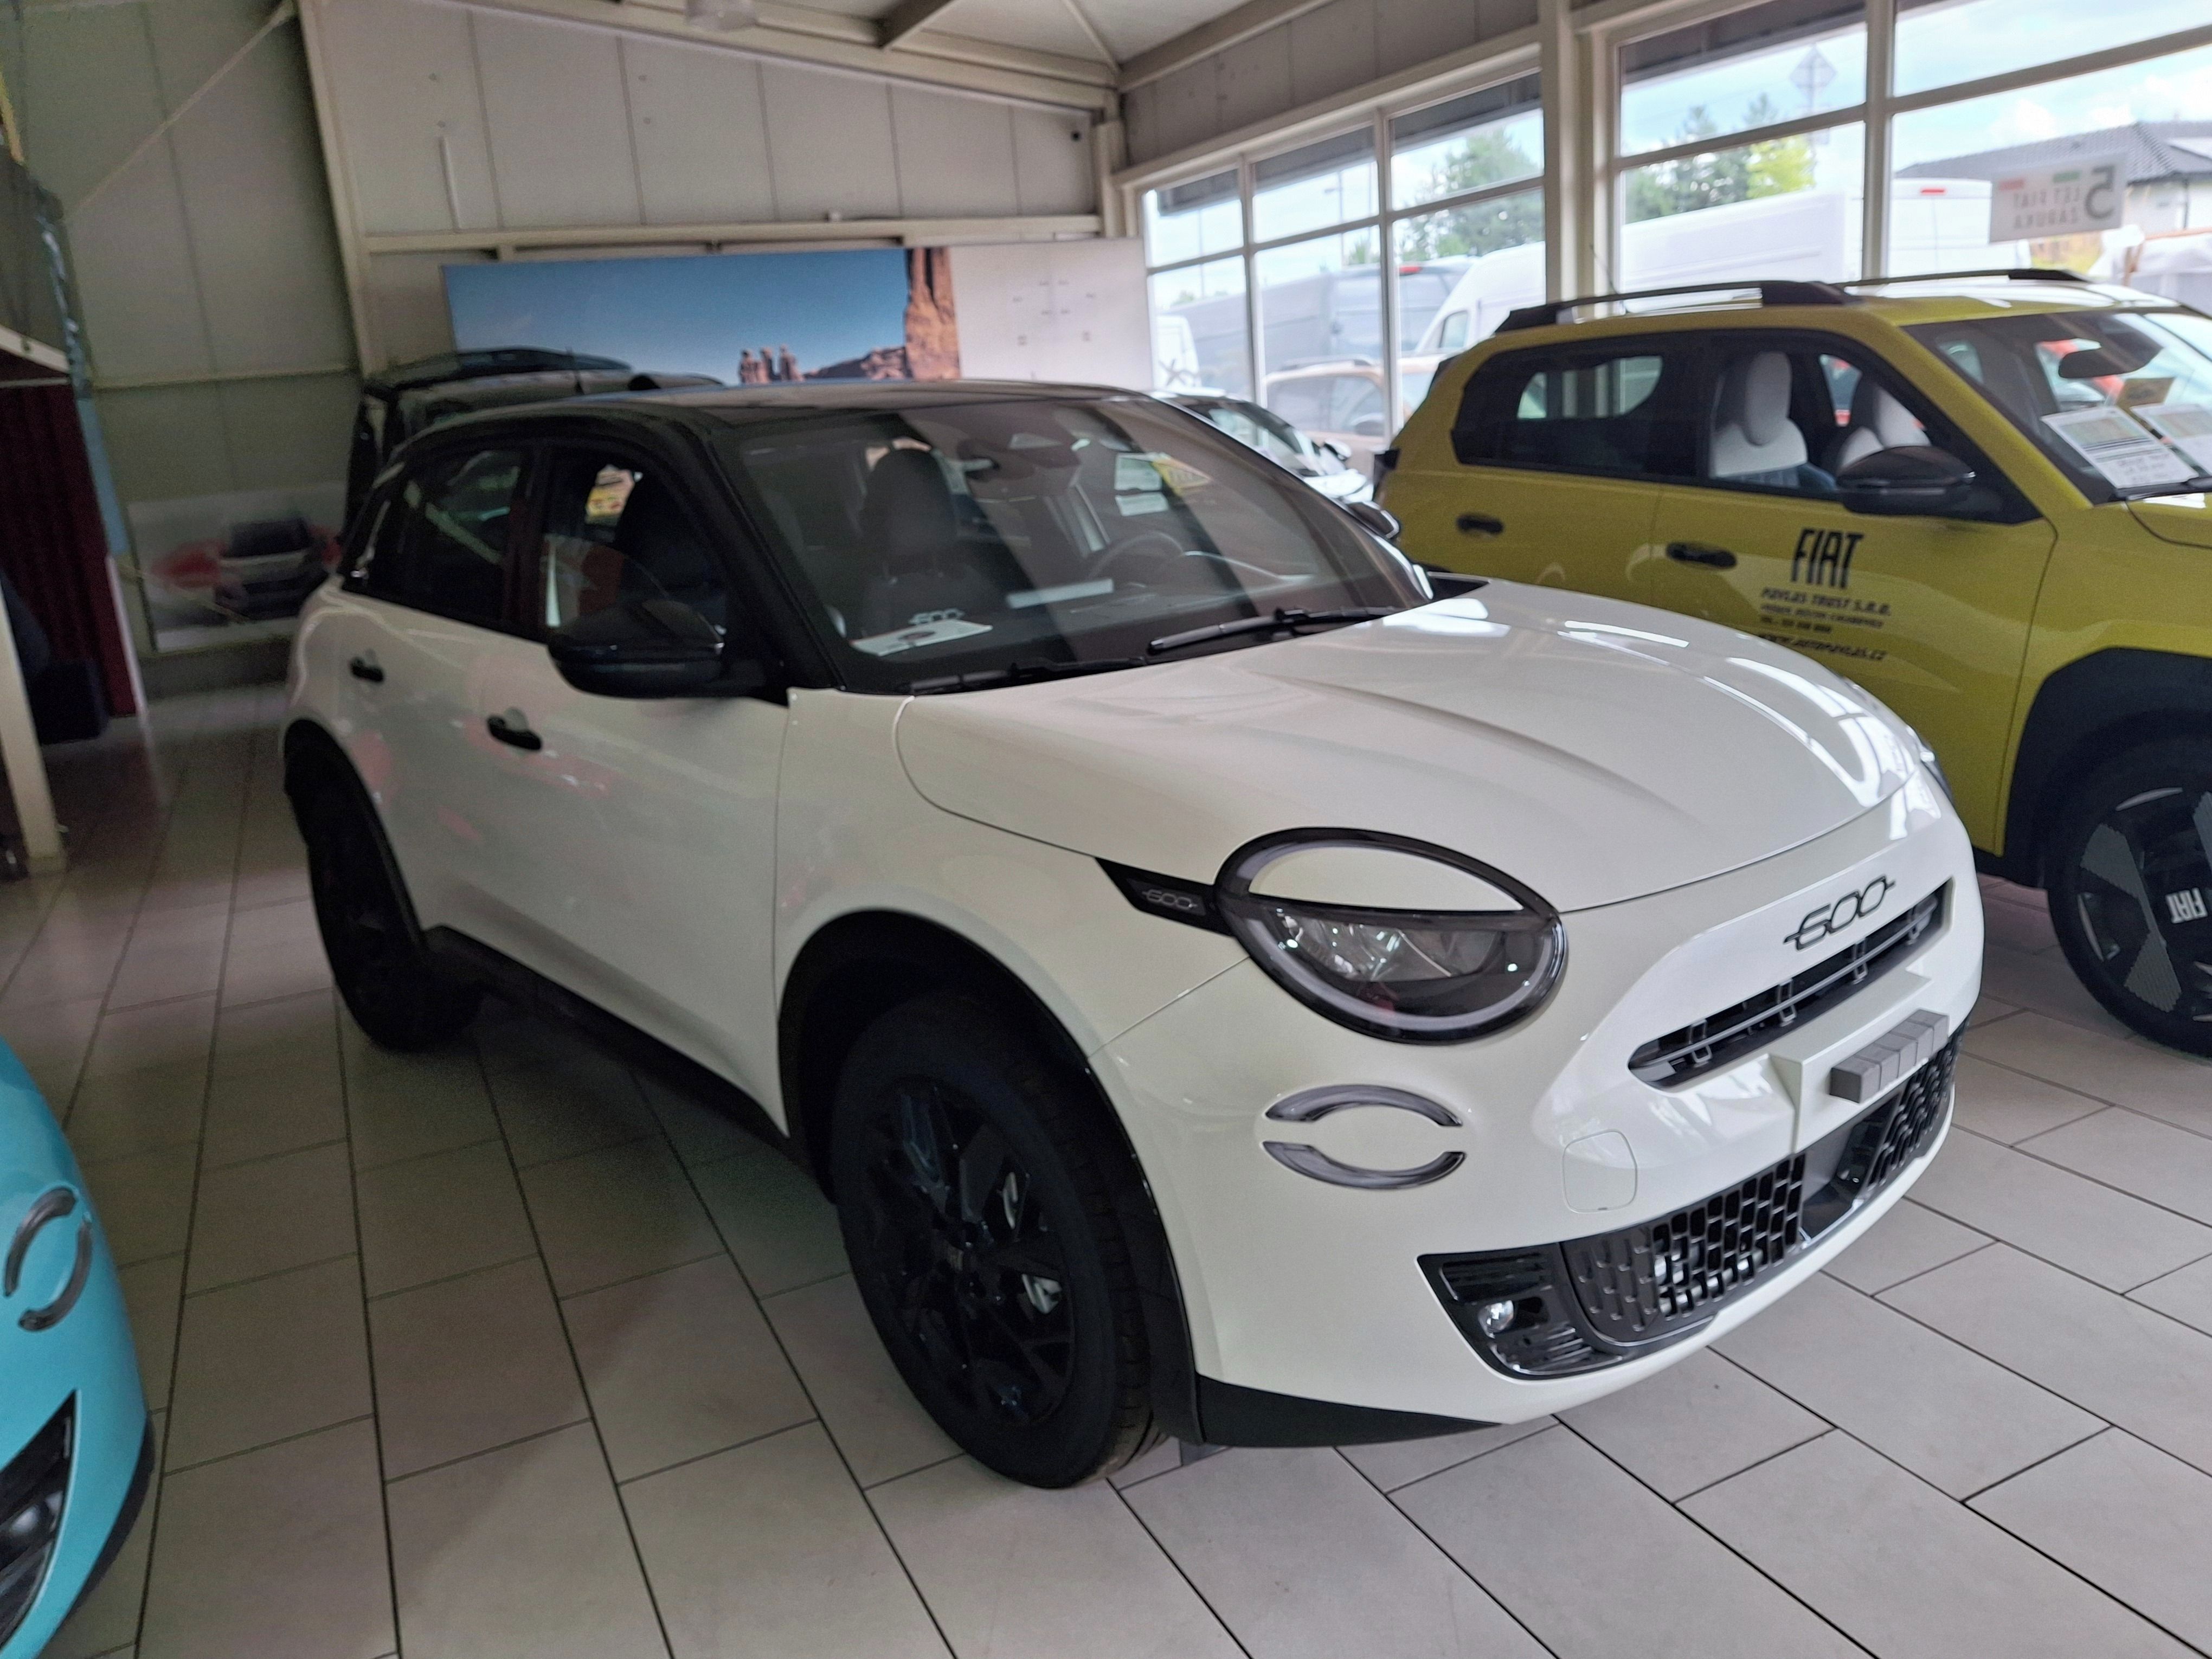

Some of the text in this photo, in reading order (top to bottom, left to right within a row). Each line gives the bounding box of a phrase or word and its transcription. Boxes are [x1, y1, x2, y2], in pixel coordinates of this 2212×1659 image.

[1792, 528, 1864, 589] FIAT
[1142, 889, 1198, 910] 600
[1783, 875, 1895, 950] 600
